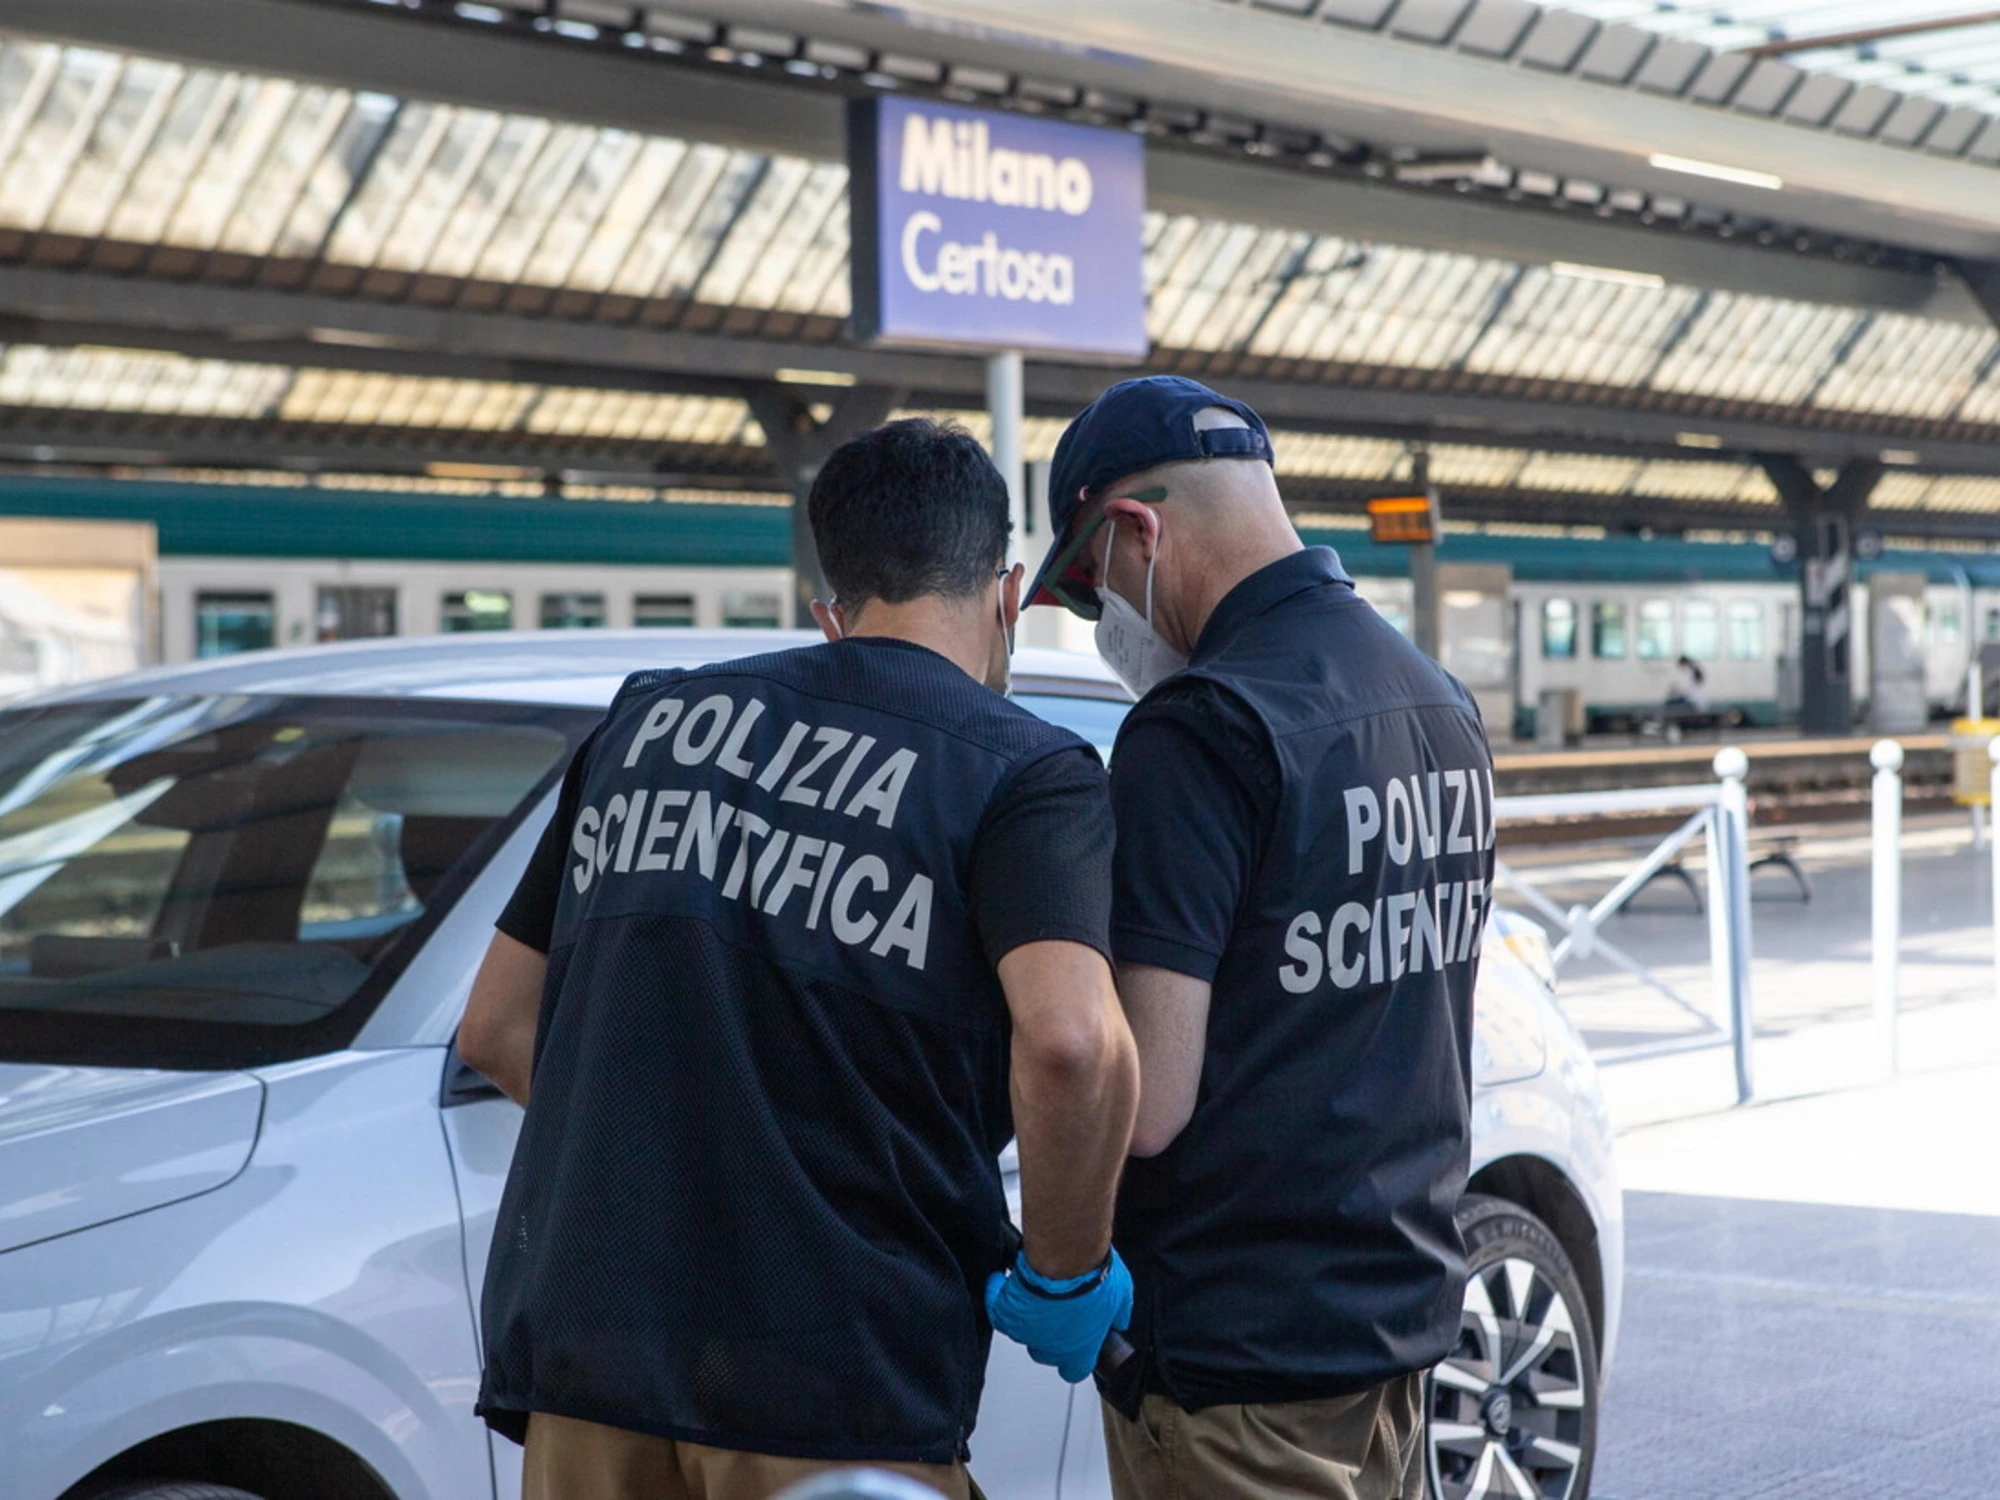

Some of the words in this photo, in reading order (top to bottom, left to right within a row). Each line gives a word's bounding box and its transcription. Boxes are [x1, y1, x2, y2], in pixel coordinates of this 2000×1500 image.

[899, 111, 1093, 216] Milano
[901, 210, 1074, 305] Certosa
[622, 694, 919, 829] POLIZIA
[572, 789, 934, 970] SCIENTIFICA
